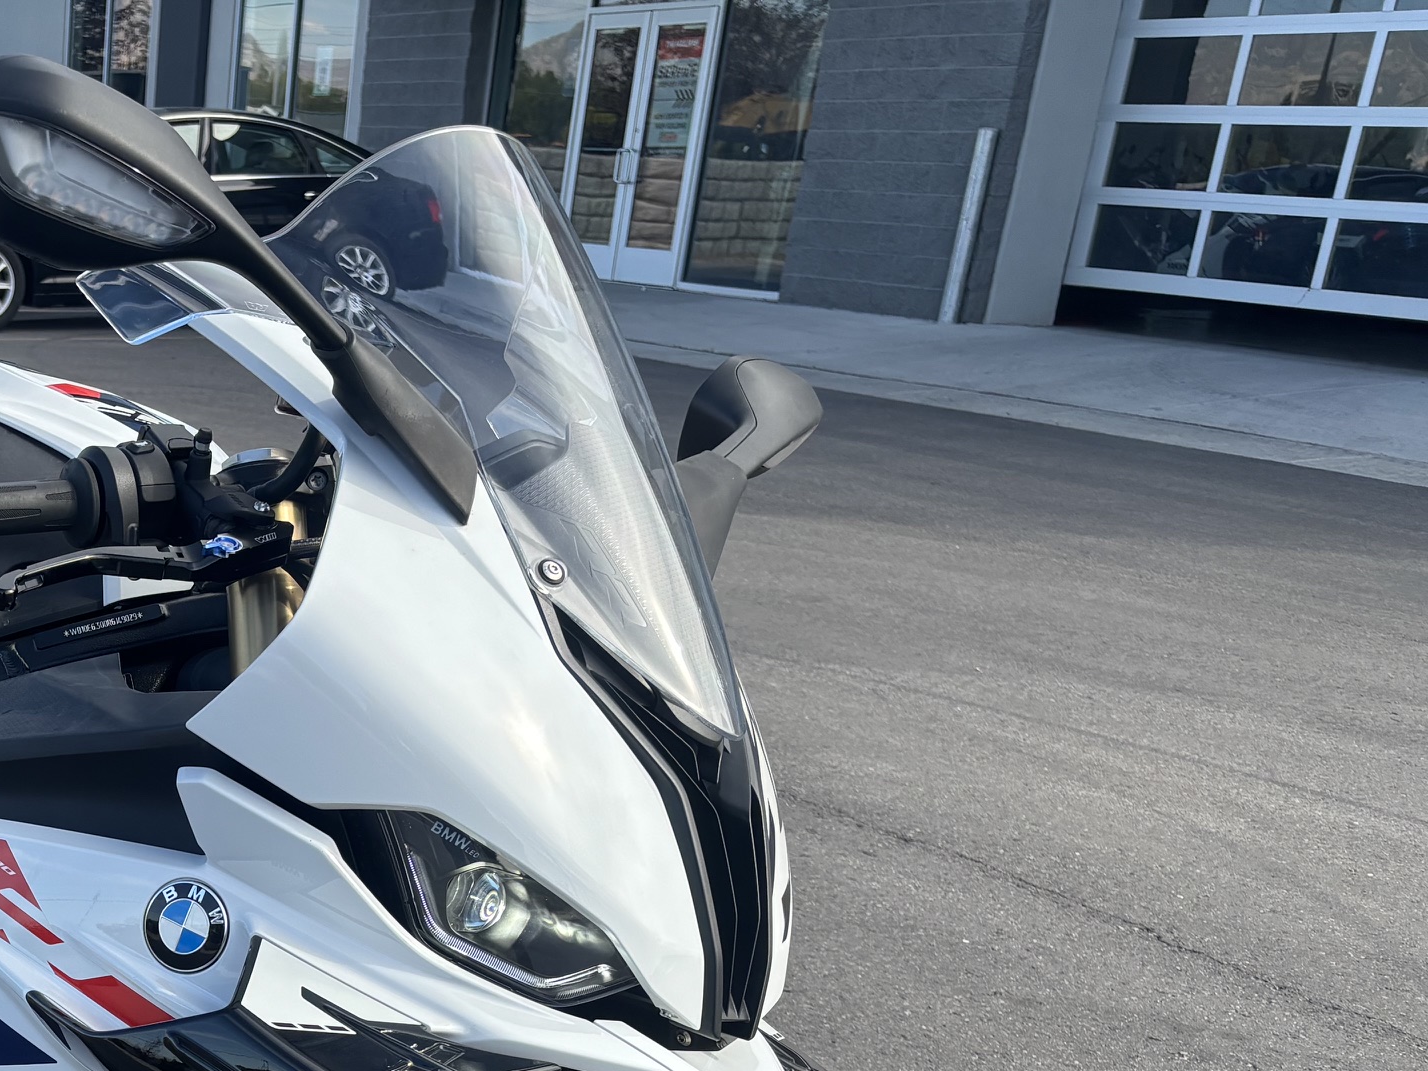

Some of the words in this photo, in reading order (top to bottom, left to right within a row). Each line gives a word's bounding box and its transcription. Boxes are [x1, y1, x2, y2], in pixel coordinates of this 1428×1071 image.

[431, 821, 471, 850] BMW
[465, 847, 480, 858] LED
[162, 884, 224, 925] BMW
